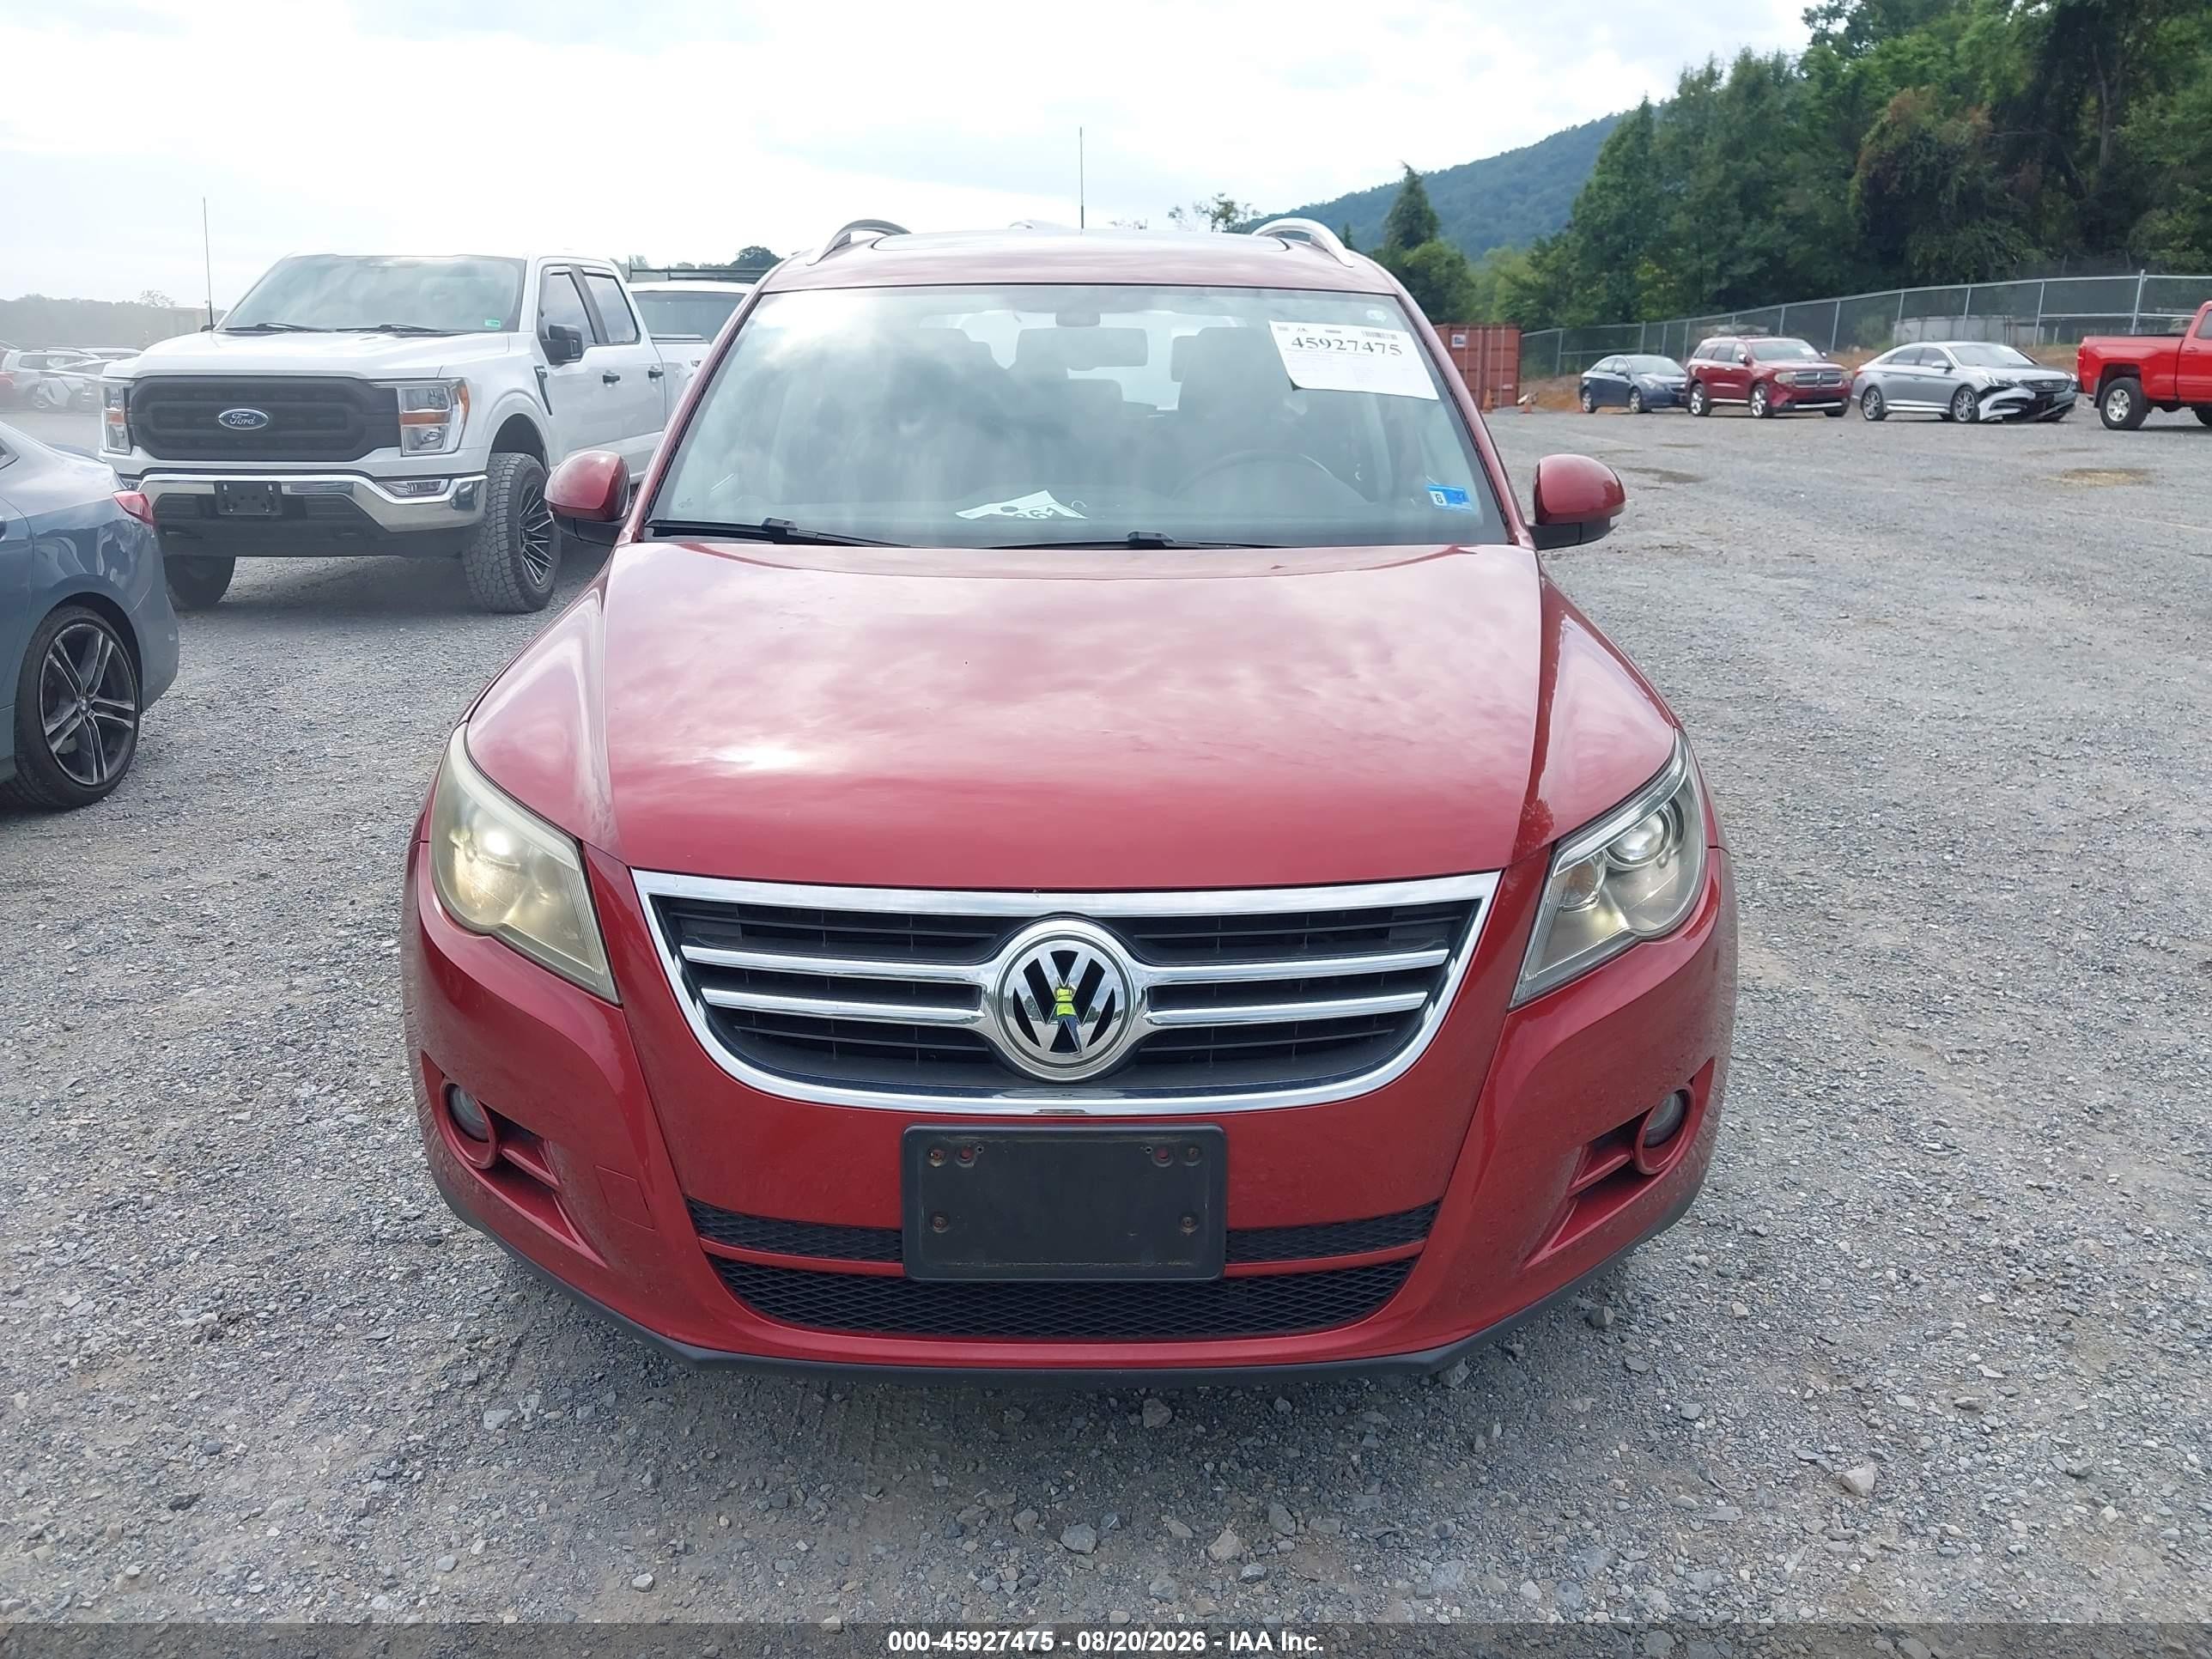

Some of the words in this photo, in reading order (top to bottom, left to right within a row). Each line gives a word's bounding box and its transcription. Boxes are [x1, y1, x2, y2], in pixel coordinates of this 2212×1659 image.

[1291, 337, 1402, 356] 45927475
[229, 412, 256, 425] Ford
[1006, 942, 1121, 1061] VW
